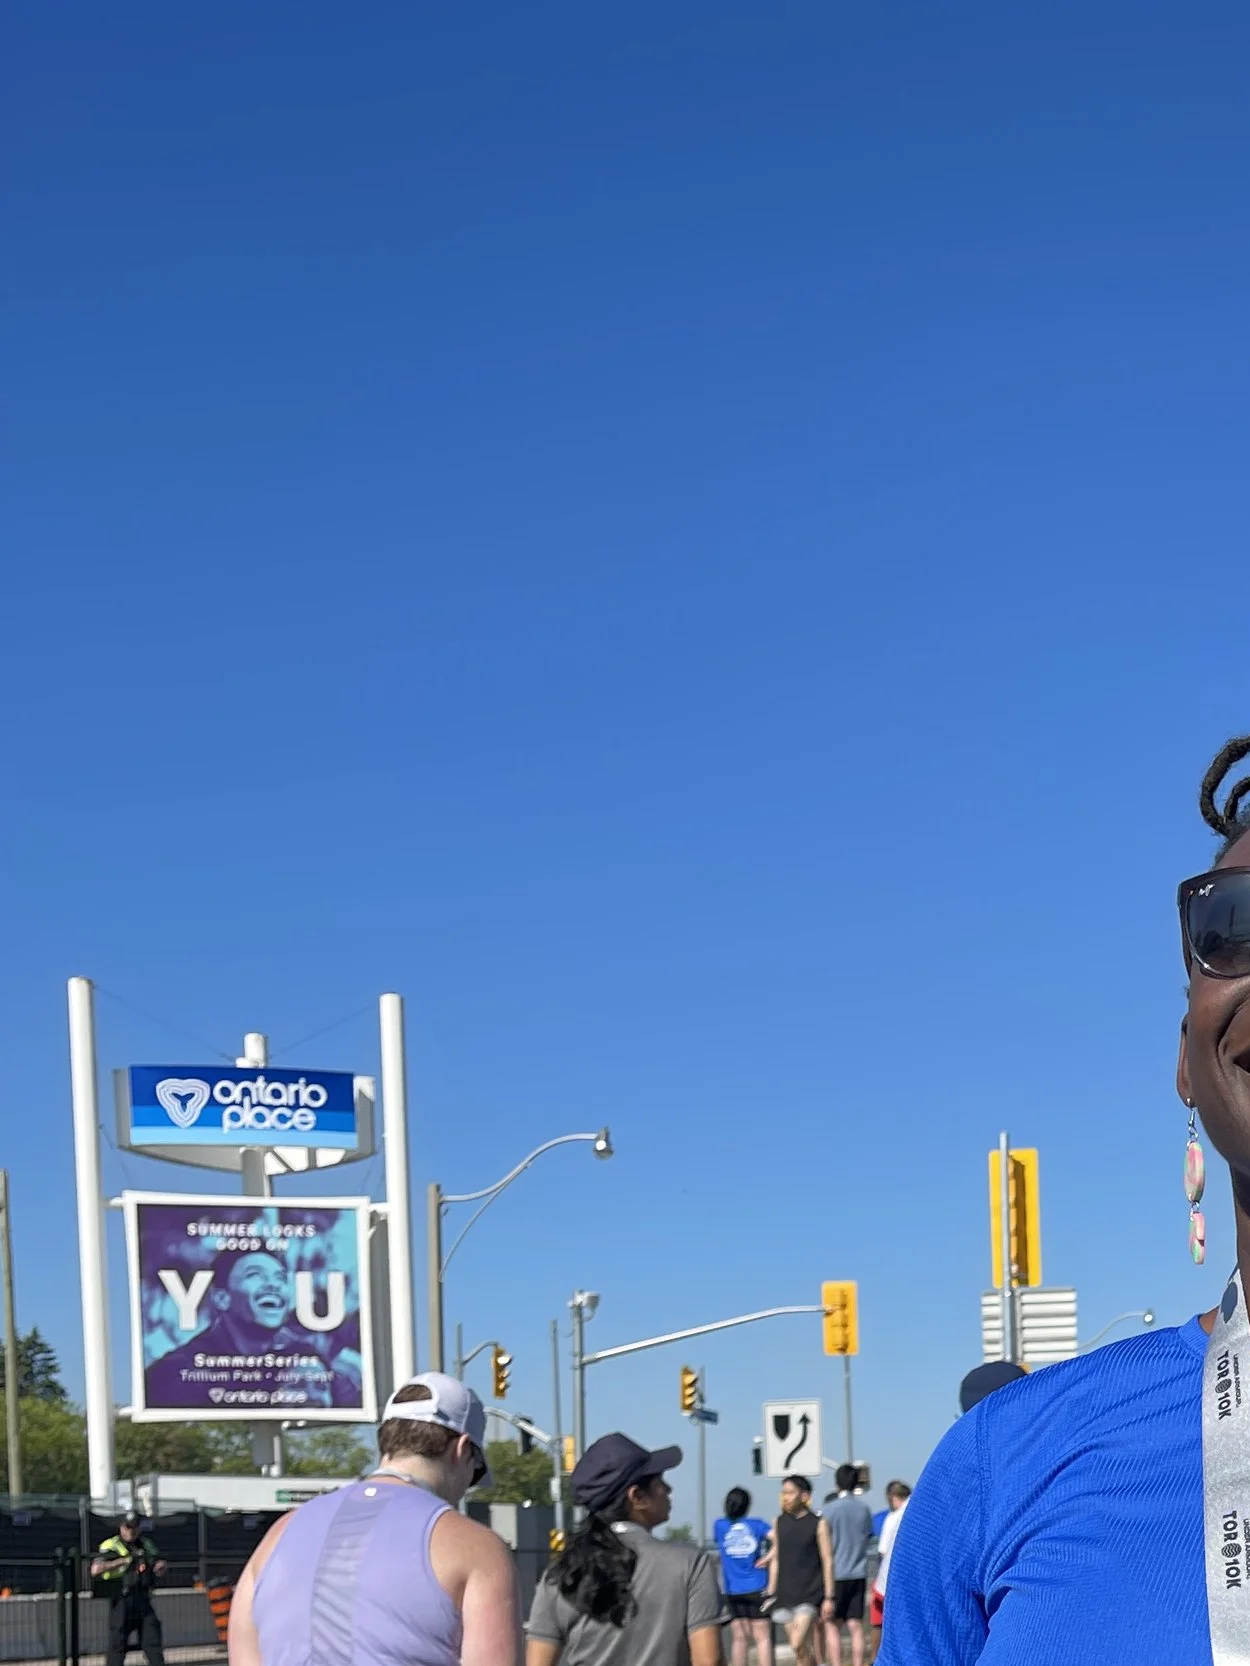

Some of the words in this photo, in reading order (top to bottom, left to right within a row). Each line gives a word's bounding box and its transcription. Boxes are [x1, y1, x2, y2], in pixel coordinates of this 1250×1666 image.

[213, 1075, 328, 1108] ontario
[222, 1097, 317, 1134] place
[187, 1222, 257, 1237] SUMMER
[263, 1223, 316, 1238] LOOKS
[215, 1237, 262, 1251] GOOD
[265, 1238, 290, 1251] ON
[233, 1369, 262, 1382] Park
[1217, 1350, 1230, 1381] TOR
[1218, 1392, 1232, 1420] 10K
[1222, 1510, 1238, 1542] TOR
[1243, 1518, 1250, 1544] UNDER
[1225, 1558, 1242, 1590] 10K
